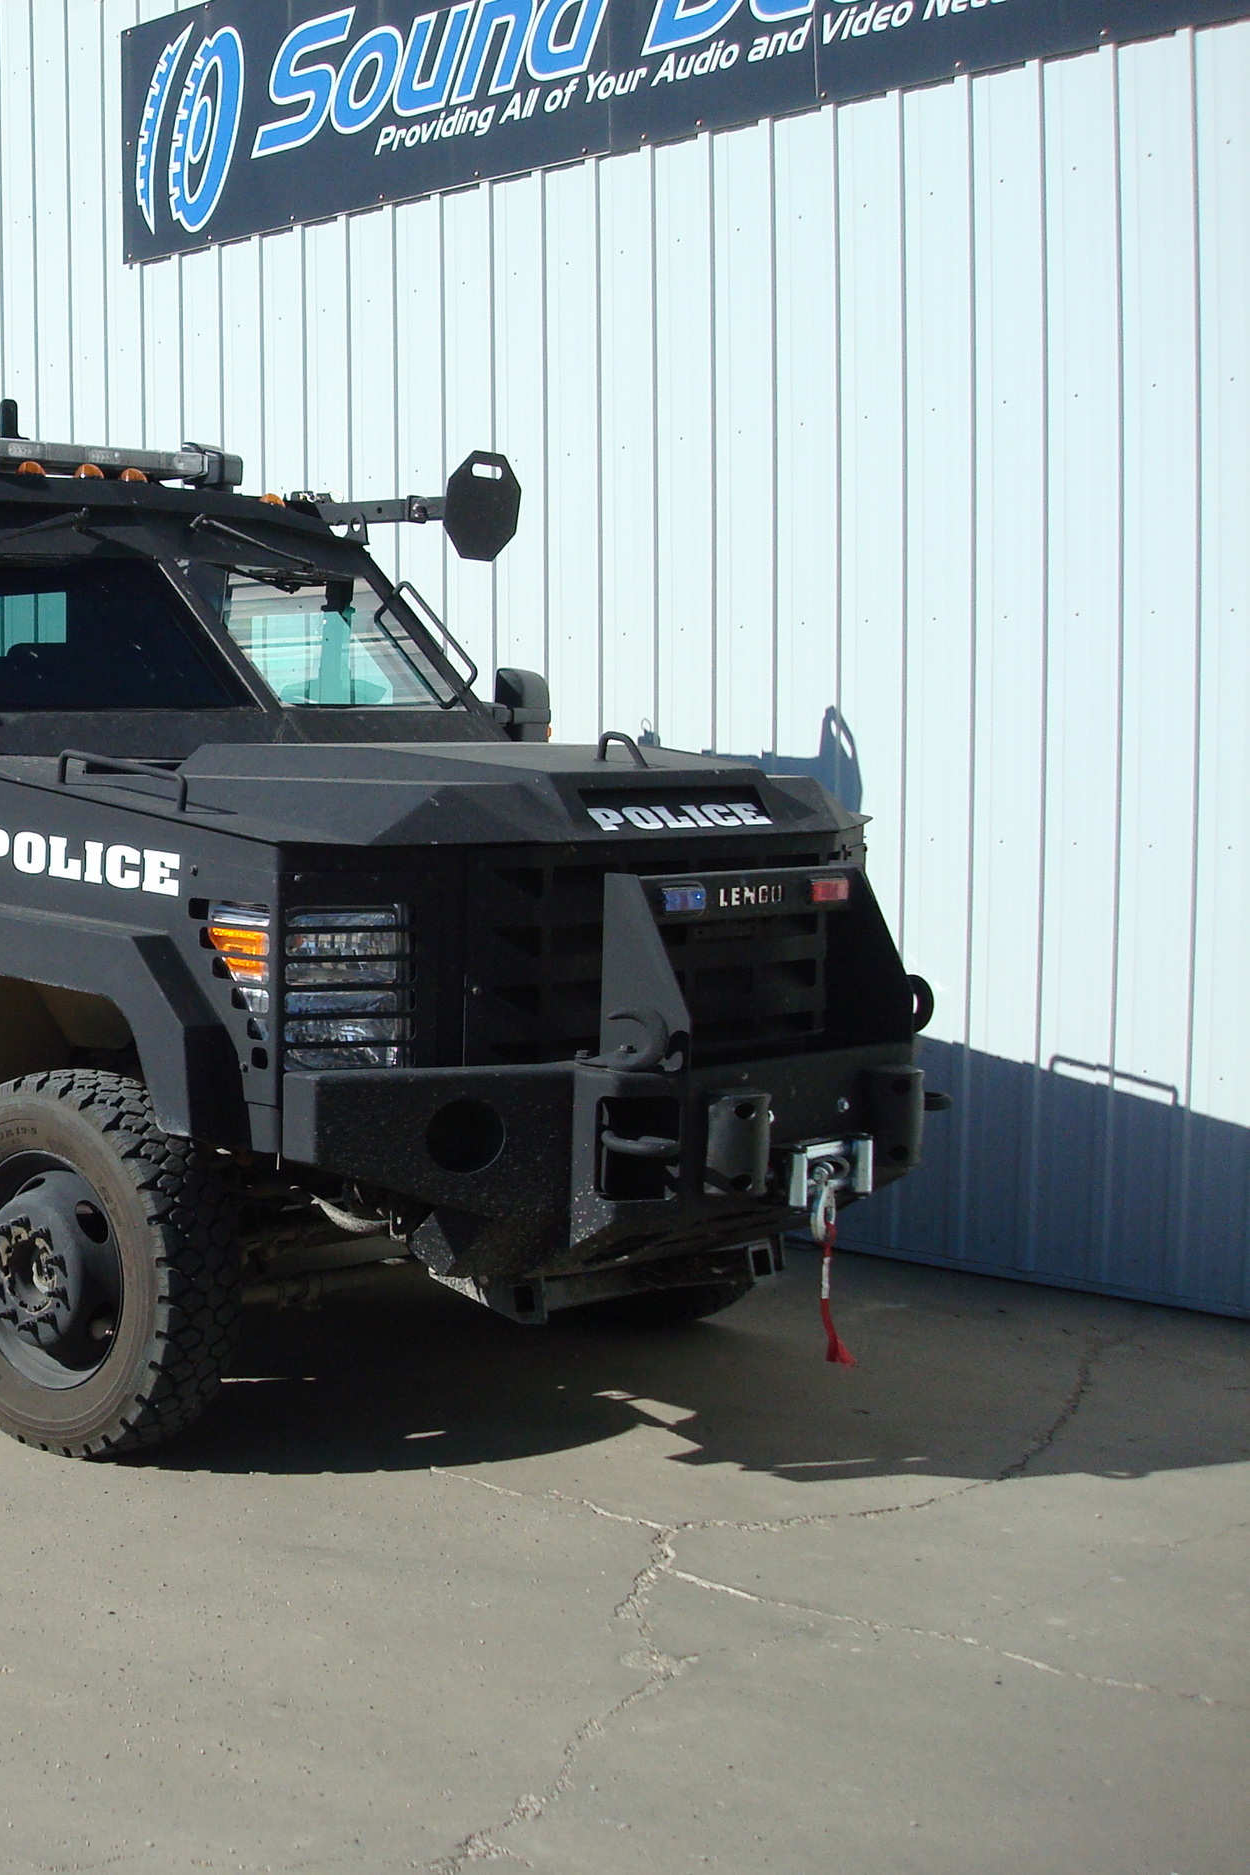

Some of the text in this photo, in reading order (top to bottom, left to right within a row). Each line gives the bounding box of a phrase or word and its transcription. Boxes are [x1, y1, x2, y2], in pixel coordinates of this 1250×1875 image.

[374, 104, 496, 155] Providing
[499, 87, 540, 124] All
[544, 77, 580, 113] of
[584, 67, 648, 104] Your
[651, 39, 740, 87] Audio
[747, 17, 813, 63] and
[822, 0, 915, 45] Video
[586, 802, 773, 832] POLICE
